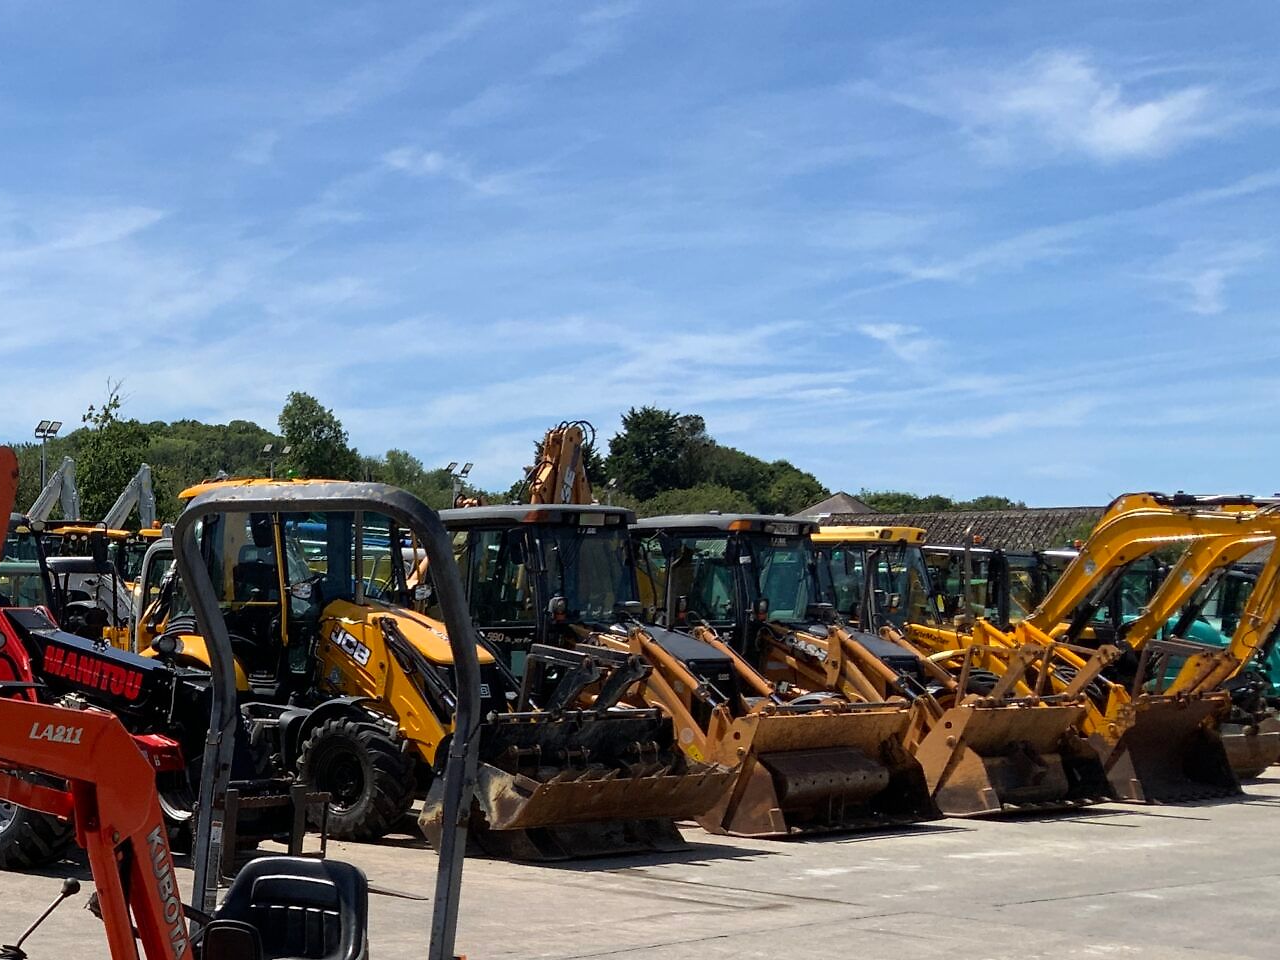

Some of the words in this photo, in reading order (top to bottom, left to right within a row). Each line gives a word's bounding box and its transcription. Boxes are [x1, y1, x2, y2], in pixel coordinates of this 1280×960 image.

[331, 625, 371, 666] JCB
[43, 645, 144, 700] MANITOU
[29, 722, 84, 745] LA211
